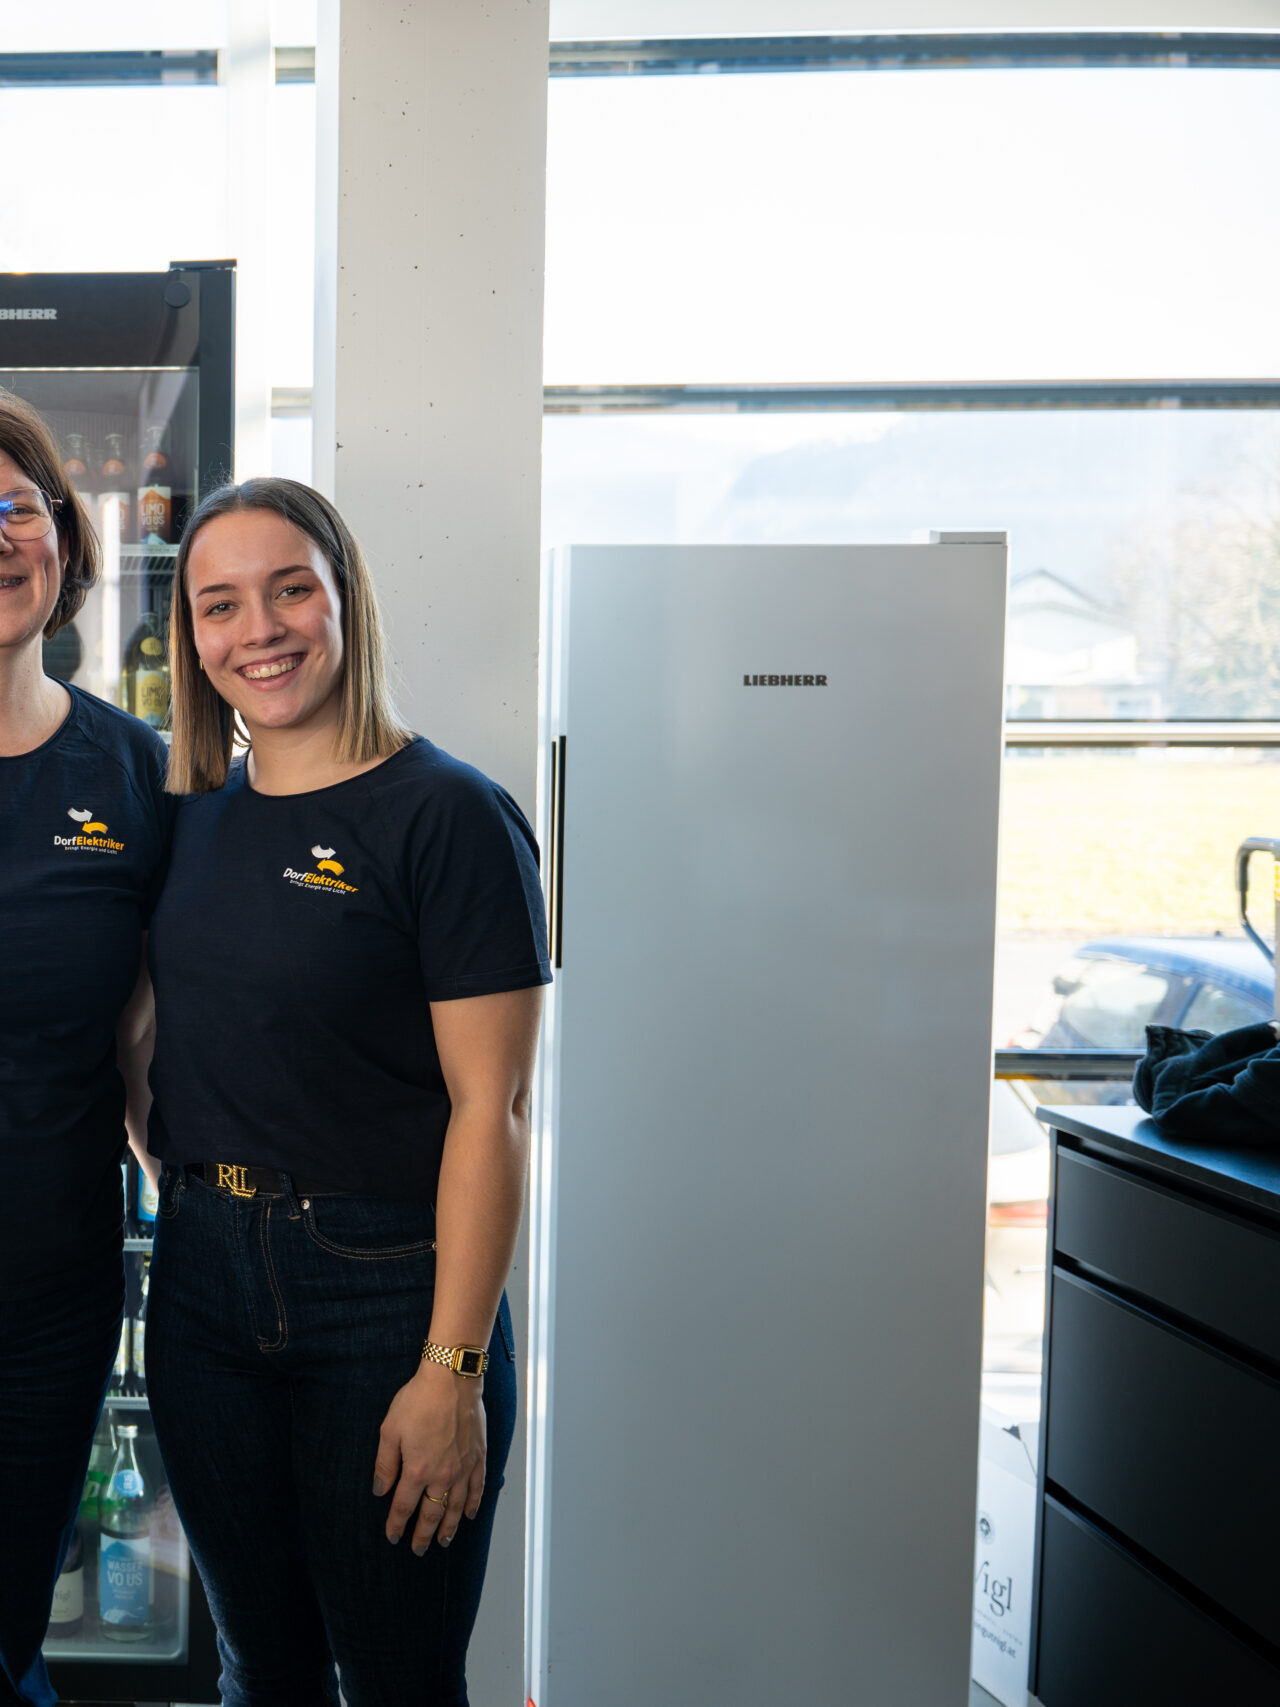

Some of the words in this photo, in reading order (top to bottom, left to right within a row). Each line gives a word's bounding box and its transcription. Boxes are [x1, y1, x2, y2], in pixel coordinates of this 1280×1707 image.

[743, 674, 828, 687] LIEBHERR
[53, 835, 125, 851] DorfElektriker
[282, 867, 359, 893] DorfElektriker
[107, 1560, 144, 1573] WASSER
[106, 1571, 124, 1586] VO
